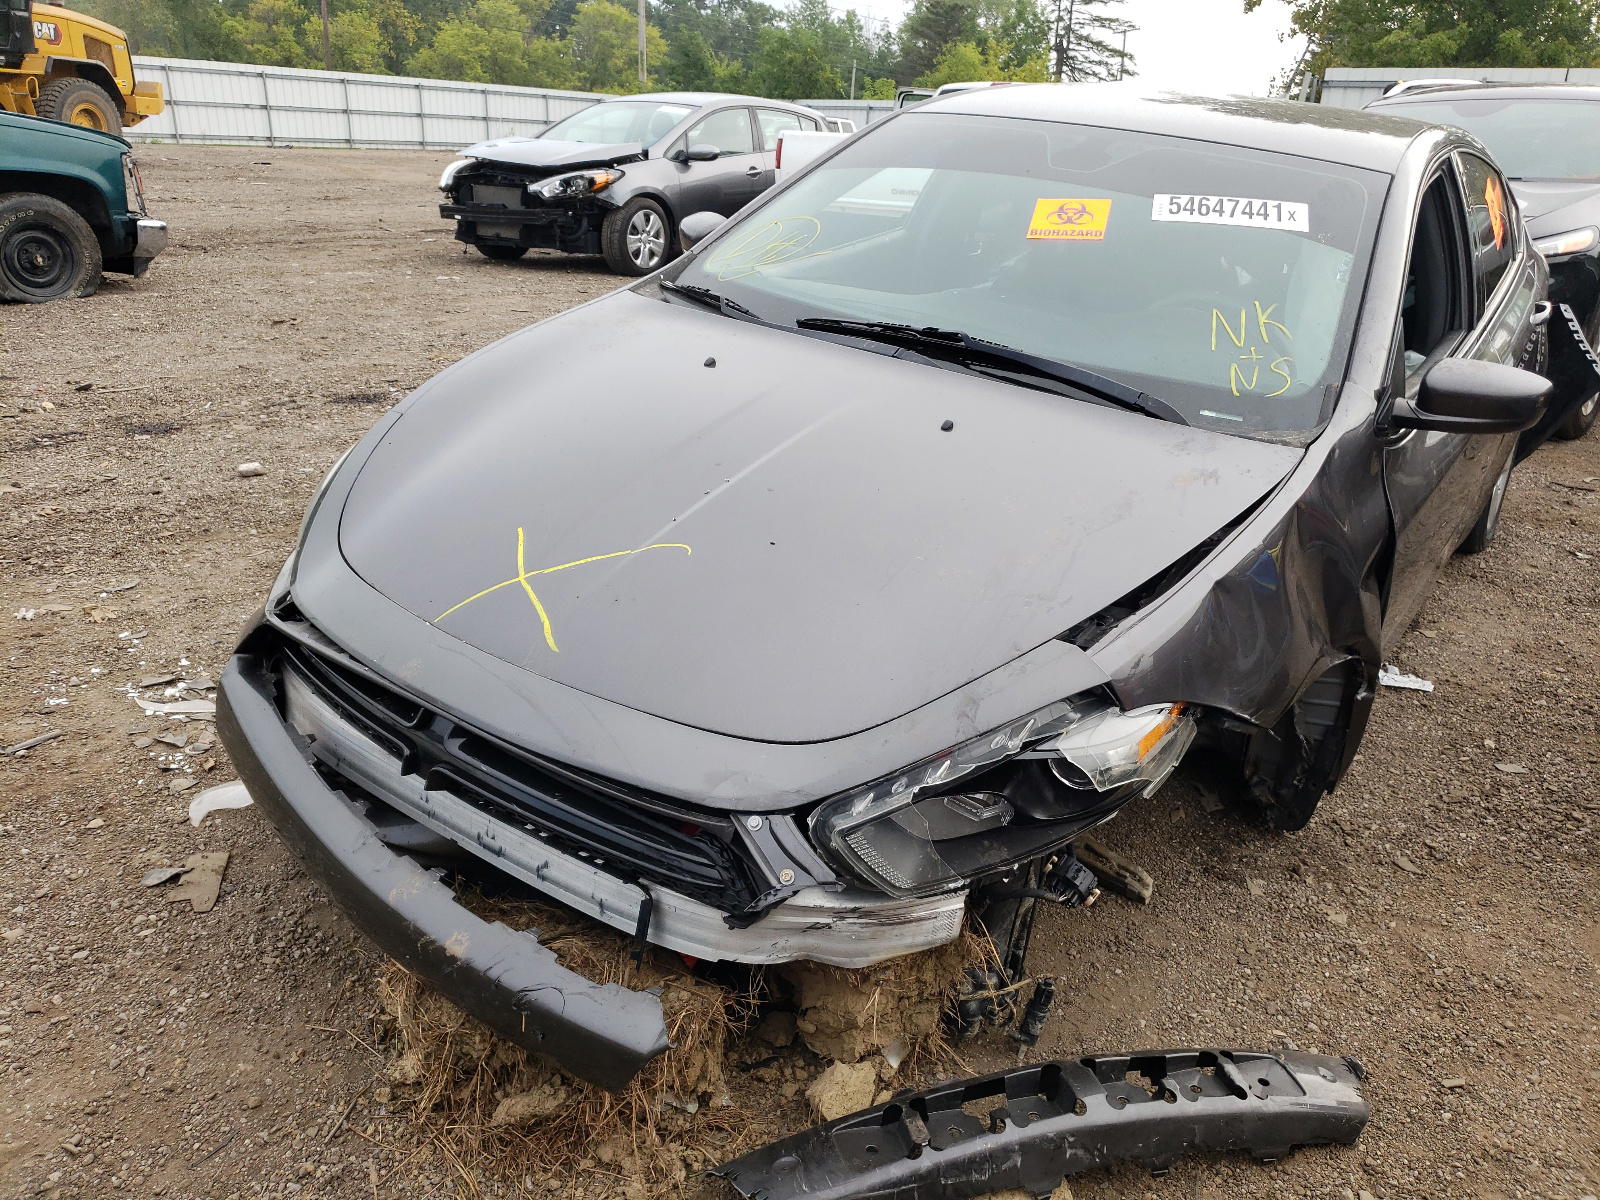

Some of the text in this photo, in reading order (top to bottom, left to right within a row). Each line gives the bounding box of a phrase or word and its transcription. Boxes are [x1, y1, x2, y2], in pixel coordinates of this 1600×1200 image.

[34, 22, 56, 41] CAT
[1168, 196, 1282, 222] 54647441
[1029, 228, 1103, 239] BIOHAZARD
[1229, 356, 1294, 398] NS
